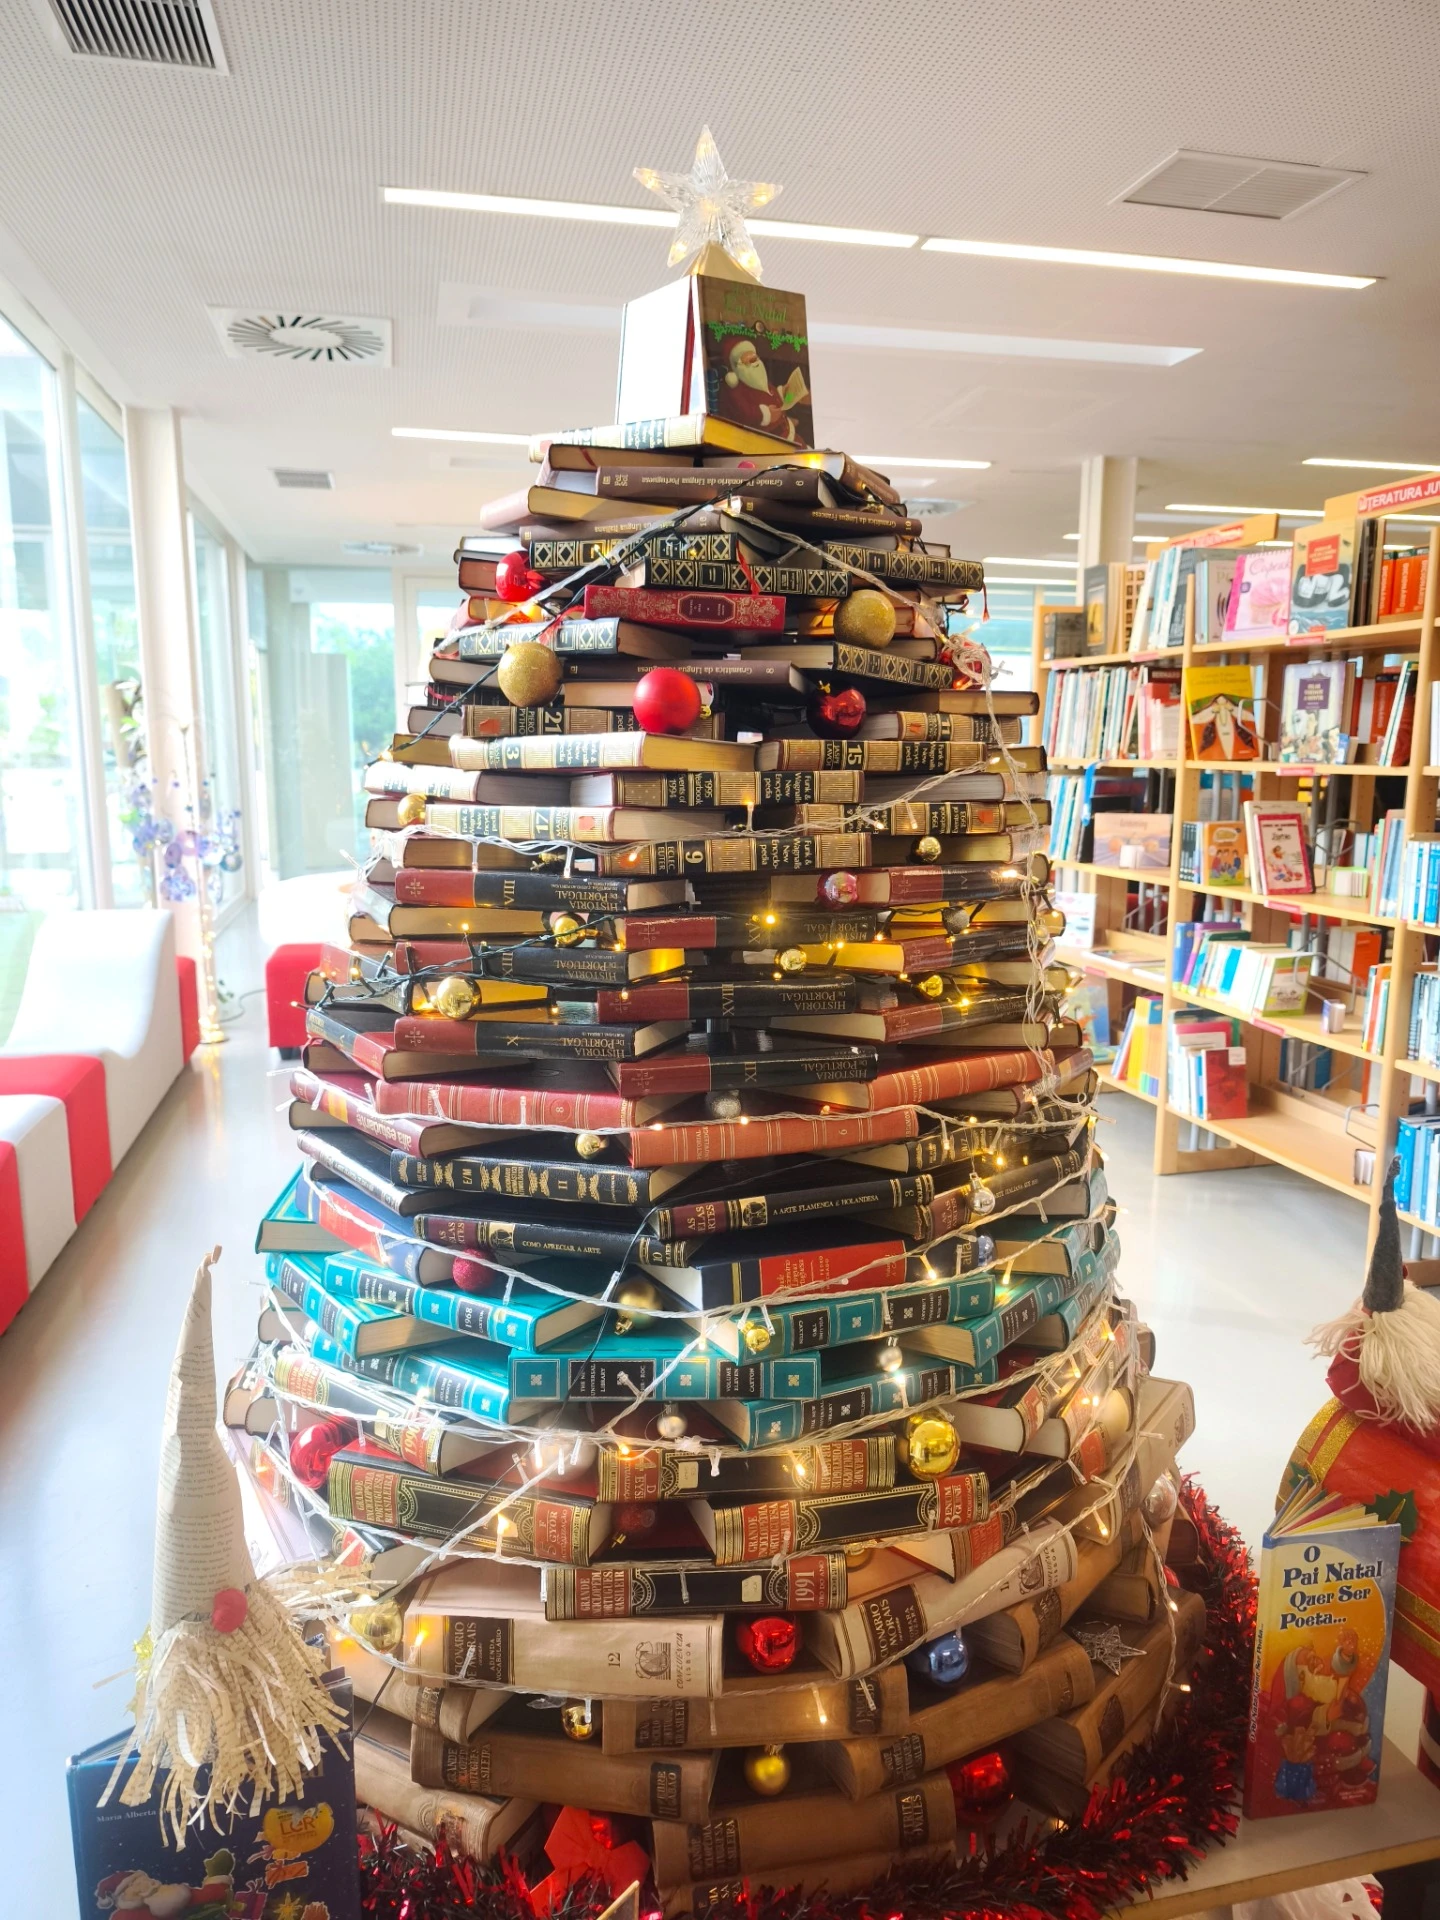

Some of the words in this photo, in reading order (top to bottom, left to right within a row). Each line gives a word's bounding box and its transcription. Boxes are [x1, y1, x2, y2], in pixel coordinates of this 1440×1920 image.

[641, 475, 680, 486] Portuguesa
[706, 476, 717, 485] da
[755, 479, 783, 488] Grande
[519, 708, 527, 735] PYTHO
[527, 711, 536, 733] PIERO
[545, 711, 563, 733] 21
[506, 746, 520, 759] 3
[847, 744, 863, 765] 15
[904, 746, 913, 765] pedia
[937, 744, 945, 761] Funk
[704, 779, 712, 798] 1995
[763, 778, 772, 798] pedia
[535, 812, 549, 833] 17
[685, 850, 704, 863] 9
[759, 844, 768, 865] pedia
[502, 880, 515, 905] VIII
[554, 890, 608, 901] PORTUGAL
[553, 959, 607, 971] PORTUGAL
[778, 991, 836, 1002] PORTUGAL
[506, 1035, 518, 1046] X
[559, 1038, 615, 1049] PORTUGAL
[800, 1060, 857, 1072] PORTUGAL
[695, 1130, 703, 1160] PICTORIAL
[779, 1205, 798, 1214] ARTE
[841, 1195, 879, 1205] HOLANDESA
[687, 1217, 696, 1230] AS
[522, 1240, 541, 1248] COMO
[543, 1242, 575, 1252] APRECIAR
[960, 1241, 972, 1265] alfa
[652, 1251, 662, 1262] 10
[465, 1307, 473, 1328] 1968
[853, 1451, 864, 1485] GRANDE
[354, 1480, 364, 1511] GRANDE
[374, 1472, 384, 1522] PORTUGUESA
[646, 1484, 657, 1494] D
[383, 1474, 394, 1524] BRASILEIRA
[539, 1519, 547, 1528] F
[549, 1511, 558, 1543] GYOR
[748, 1516, 758, 1553] GRANDE
[1303, 1545, 1321, 1563] O
[1282, 1566, 1319, 1589] Pai
[1325, 1559, 1383, 1584] Natal
[580, 1577, 591, 1611] GRANDE
[794, 1570, 815, 1602] 1991
[819, 1579, 825, 1590] DO
[1289, 1589, 1335, 1612] Quer
[1337, 1584, 1372, 1602] Ser
[881, 1598, 899, 1646] MORAIS
[1279, 1611, 1347, 1631] Poeta...
[608, 1652, 621, 1668] 12
[96, 1814, 123, 1823] Maria
[125, 1810, 157, 1821] Alberta
